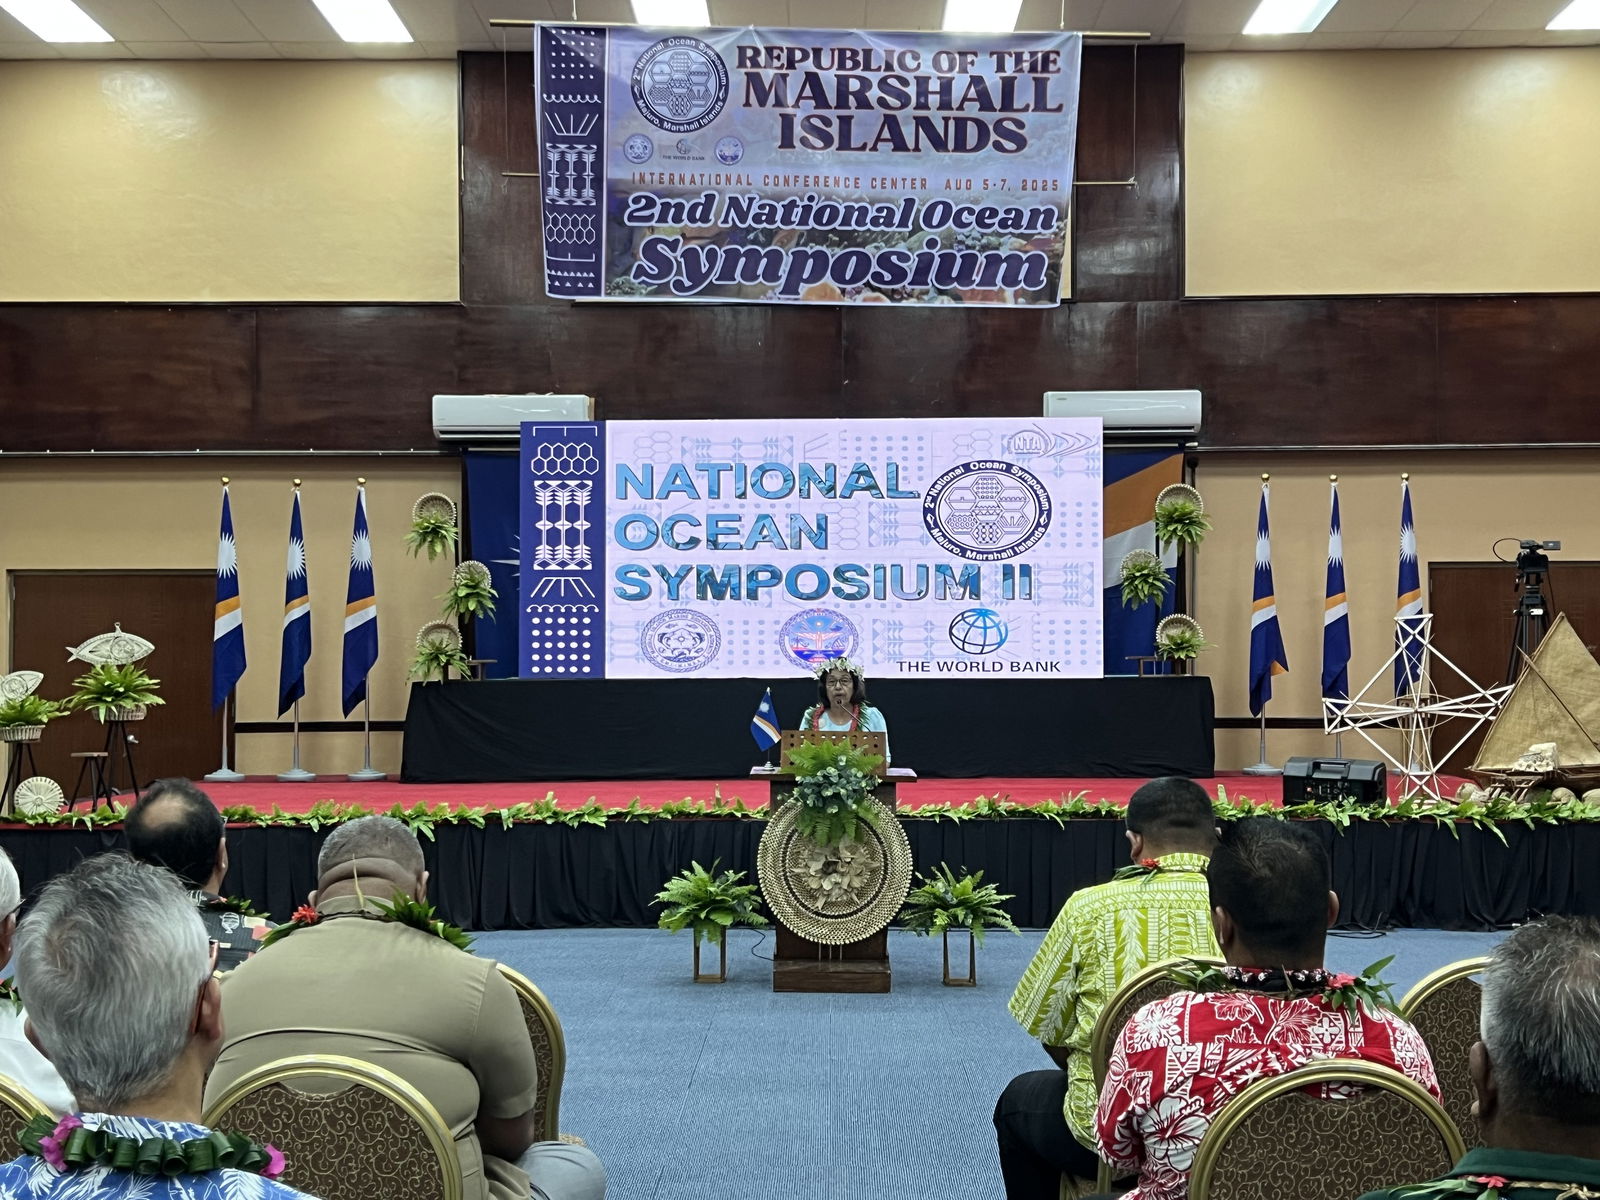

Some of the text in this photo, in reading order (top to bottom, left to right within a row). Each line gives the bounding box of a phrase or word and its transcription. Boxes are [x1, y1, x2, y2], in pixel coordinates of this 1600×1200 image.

[637, 42, 664, 70] National
[668, 38, 696, 46] Ocean
[698, 42, 727, 85] Symposium
[736, 45, 1062, 74] REPUBLIC OF THE
[742, 71, 1064, 113] MARSHALL
[663, 121, 700, 132] Marshall
[700, 101, 723, 126] Islands
[778, 113, 1029, 154] ISLANDS
[632, 171, 753, 186] INTERNATIONAL
[763, 175, 861, 189] CONFERENCE
[870, 178, 928, 190] CENTER
[1021, 179, 1059, 191] 2025
[626, 192, 1057, 232] 2nd National Ocean
[631, 236, 1047, 295] Symposium
[1014, 437, 1041, 450] NTA
[615, 462, 921, 500] NATIONAL
[931, 466, 965, 497] National
[970, 461, 1007, 471] Ocean
[1010, 465, 1050, 510] Symposium
[614, 513, 829, 550] OCEAN
[965, 549, 1015, 561] Marshall
[1015, 527, 1046, 554] Islands
[614, 563, 1033, 601] SYMPOSIUM II
[897, 661, 1061, 672] THE WORLD BANK
